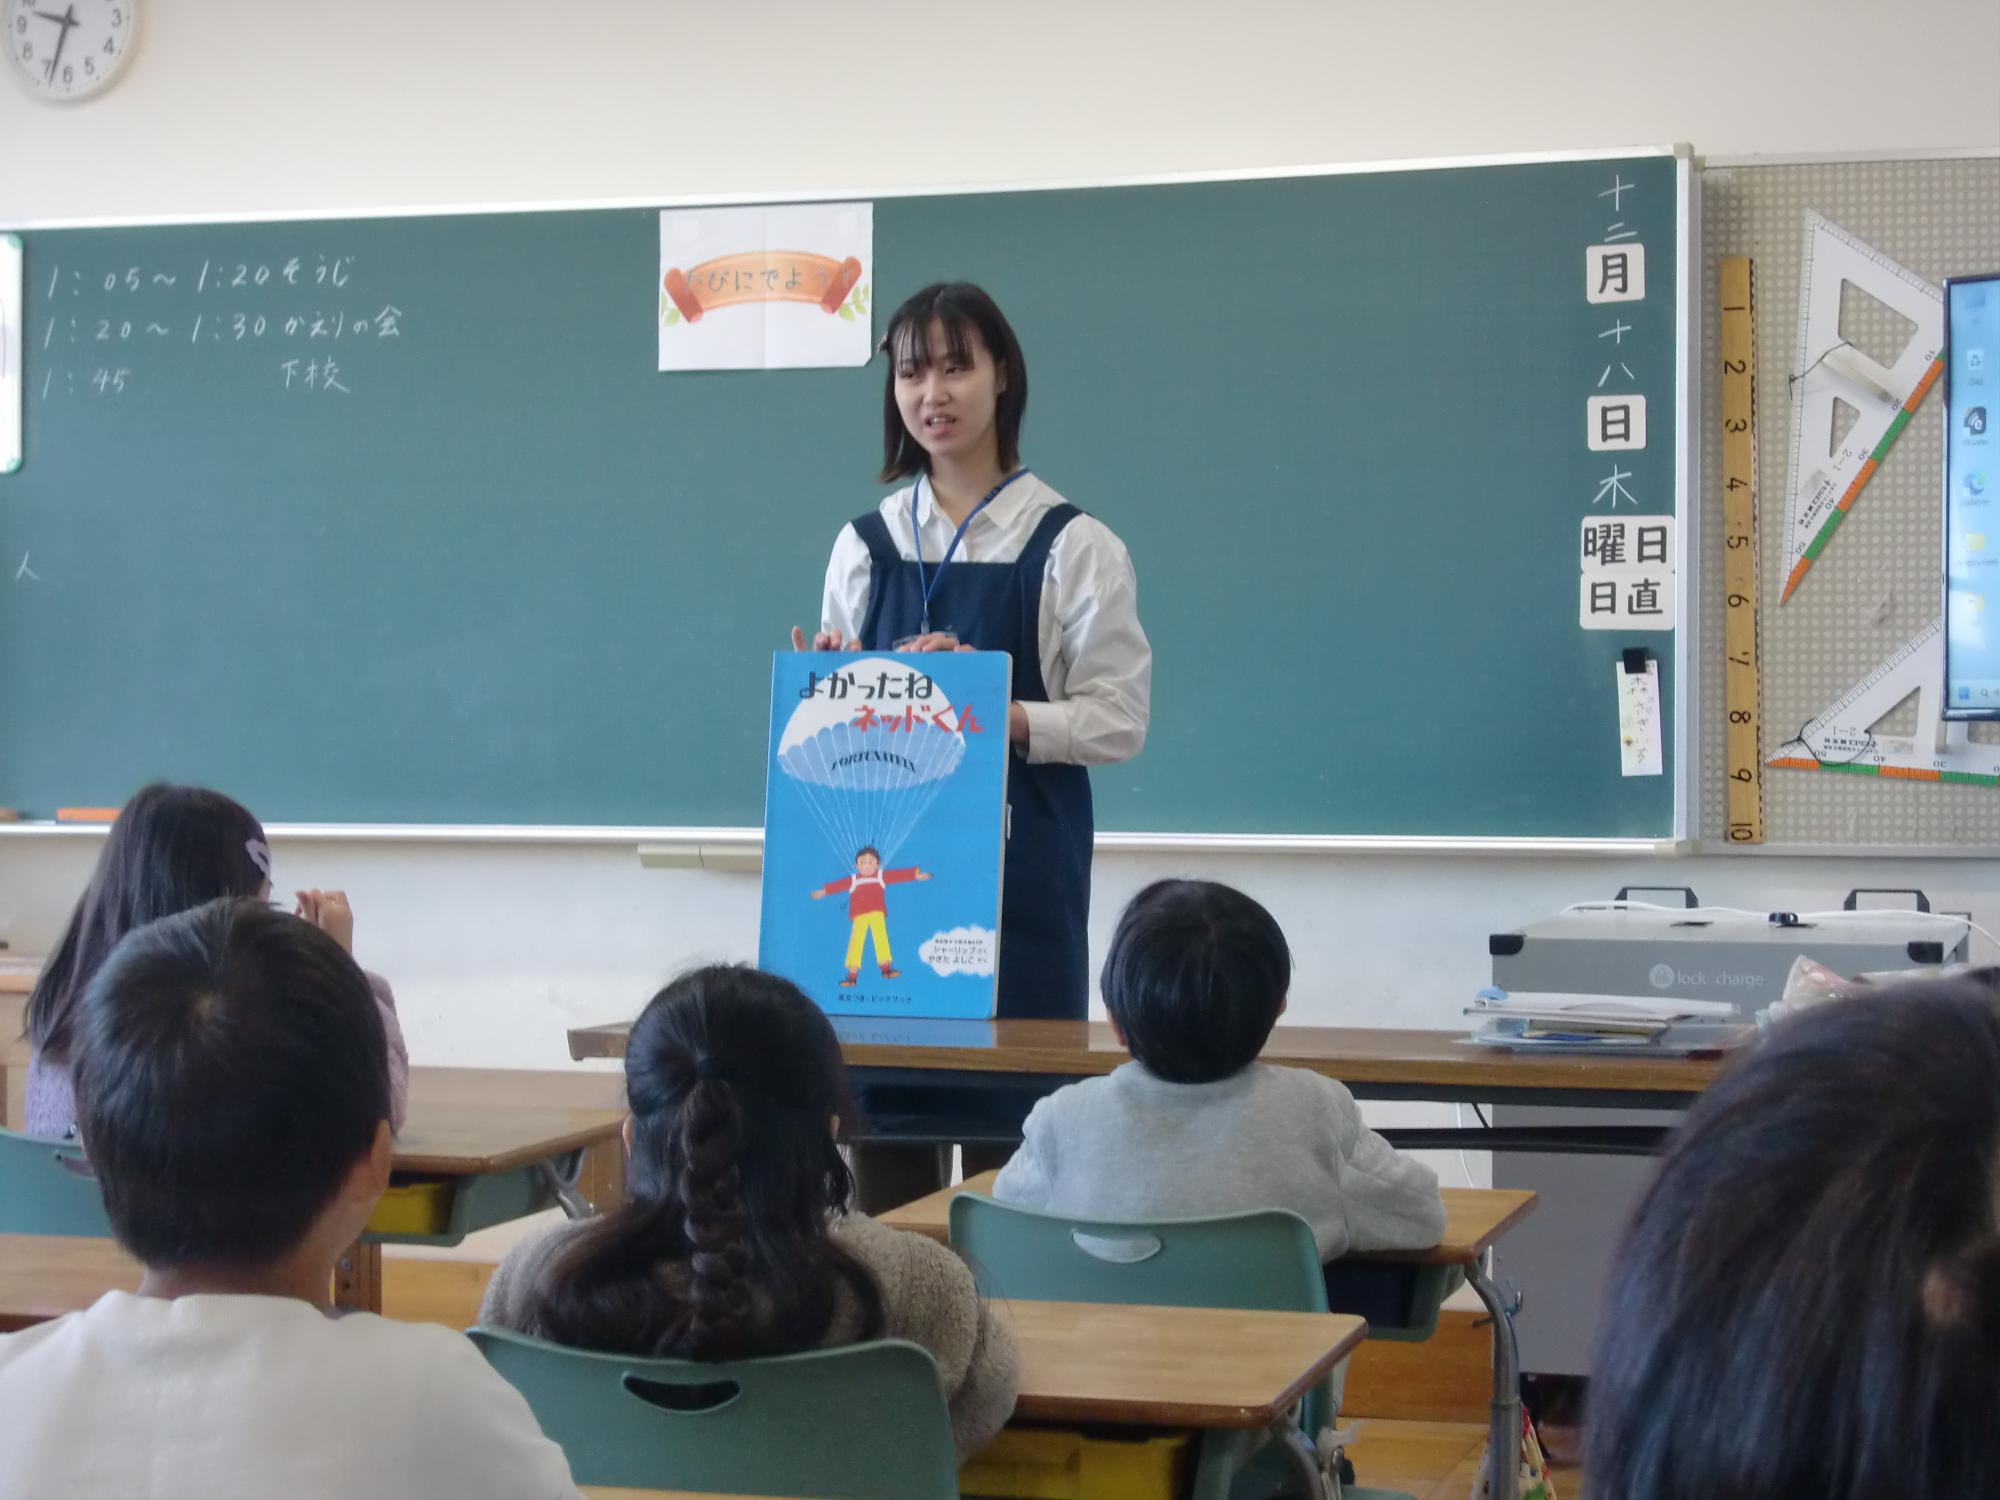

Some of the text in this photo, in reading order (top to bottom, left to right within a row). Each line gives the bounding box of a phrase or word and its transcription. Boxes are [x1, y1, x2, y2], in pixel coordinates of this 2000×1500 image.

[17, 15, 27, 35] 9
[111, 8, 122, 28] 3
[22, 41, 33, 61] 8
[104, 36, 114, 55] 4
[42, 58, 52, 78] 7
[63, 64, 73, 84] 6
[84, 55, 95, 76] 5
[1598, 252, 1628, 294] 月
[281, 355, 351, 393] 下校
[1724, 360, 1746, 375] 2
[1601, 404, 1630, 443] 日
[1725, 418, 1747, 433] 3
[1592, 463, 1637, 509] 木
[1726, 476, 1748, 492] 4
[1583, 522, 1668, 567] 曜日
[1727, 535, 1749, 549] 5
[1590, 578, 1664, 616] 日直
[1728, 594, 1750, 608] 6
[1729, 651, 1750, 666] 7
[800, 671, 933, 700] よかったね
[851, 704, 984, 734] ネッドくん
[1729, 710, 1751, 724] 8
[1730, 768, 1752, 783] 9
[1731, 822, 1752, 841] 10
[1677, 970, 1765, 989] lock charge
